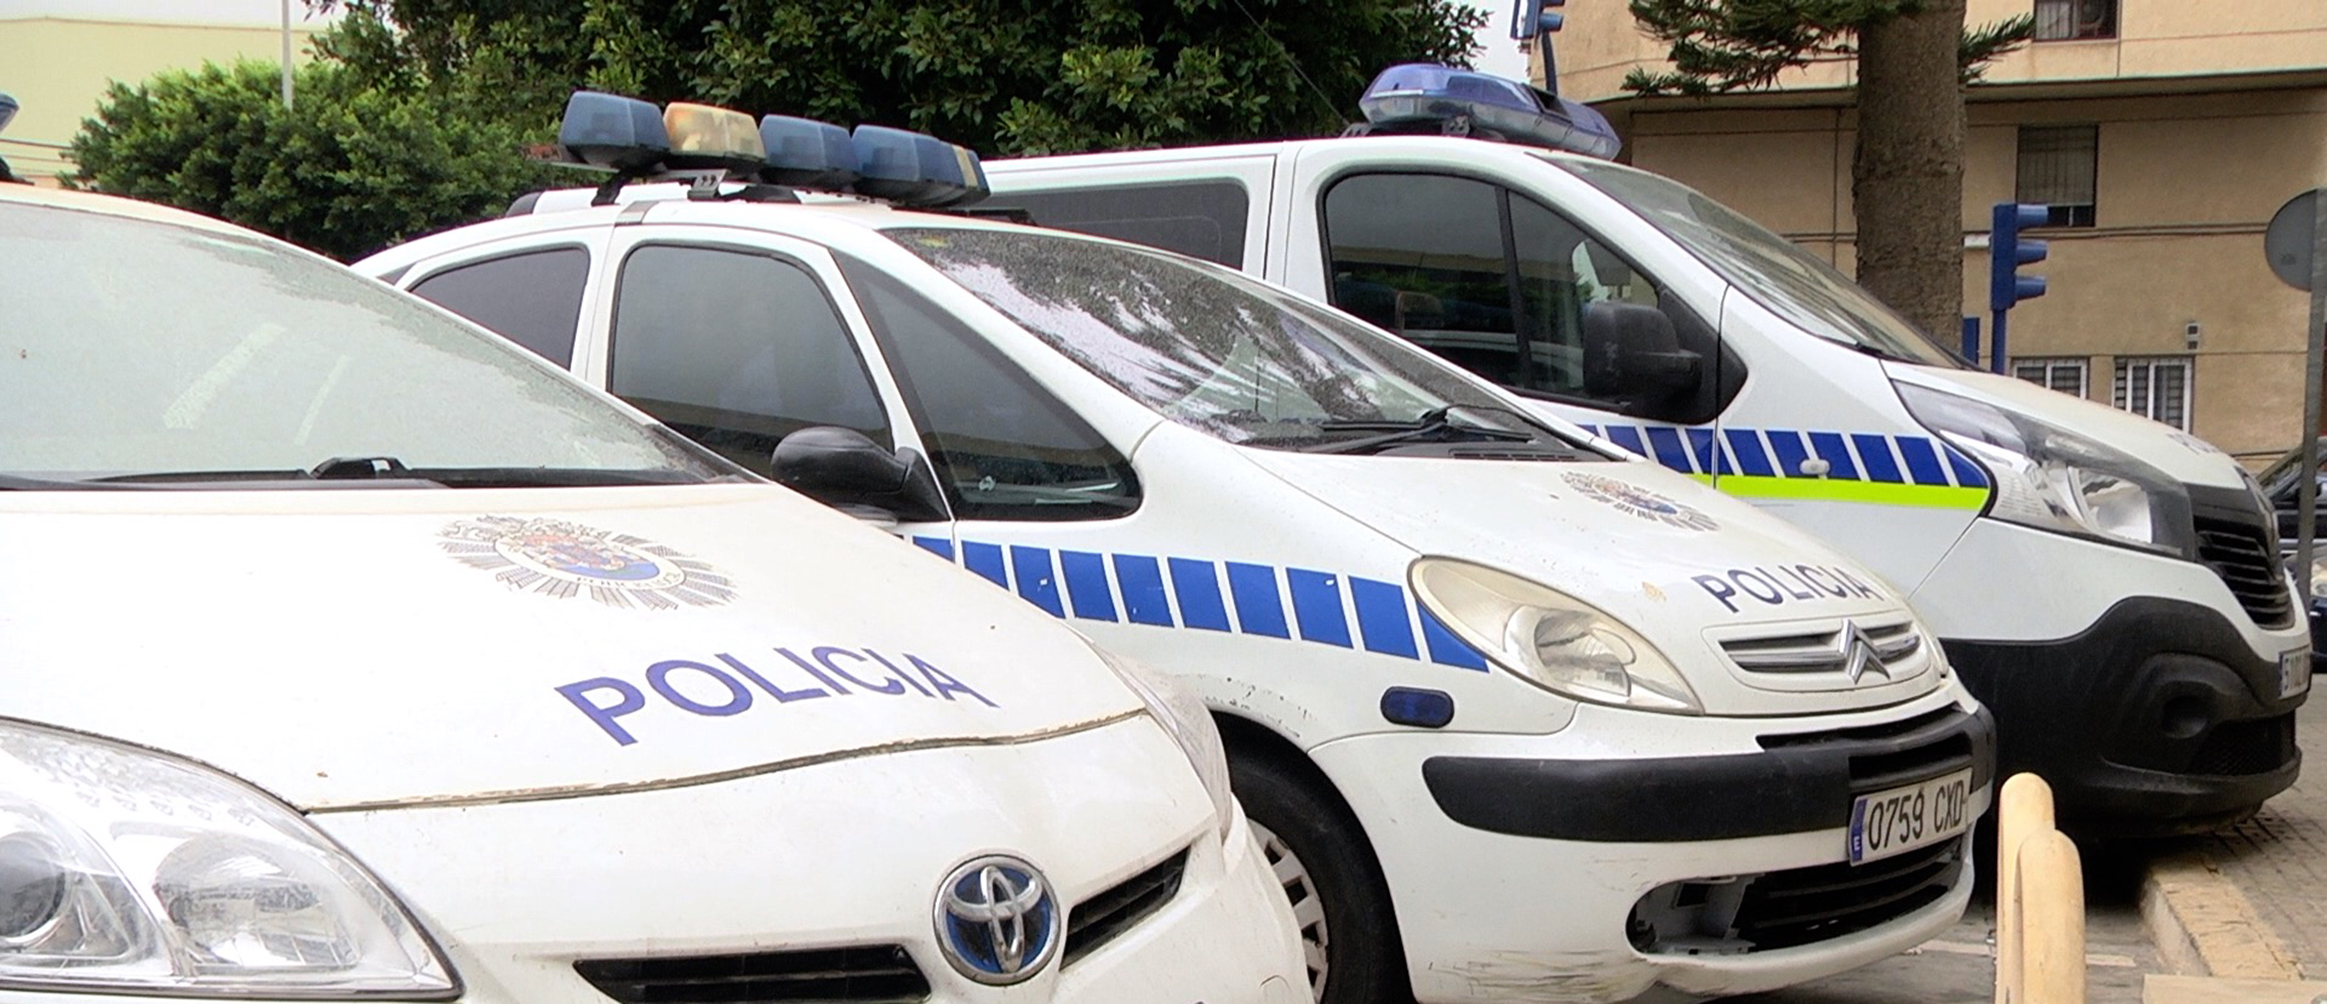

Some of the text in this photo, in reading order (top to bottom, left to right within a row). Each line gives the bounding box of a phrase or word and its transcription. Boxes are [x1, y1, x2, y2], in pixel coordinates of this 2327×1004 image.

[1691, 564, 1885, 613] POLICIA
[553, 645, 1001, 747] POLICIA
[1868, 789, 1925, 850] 0759
